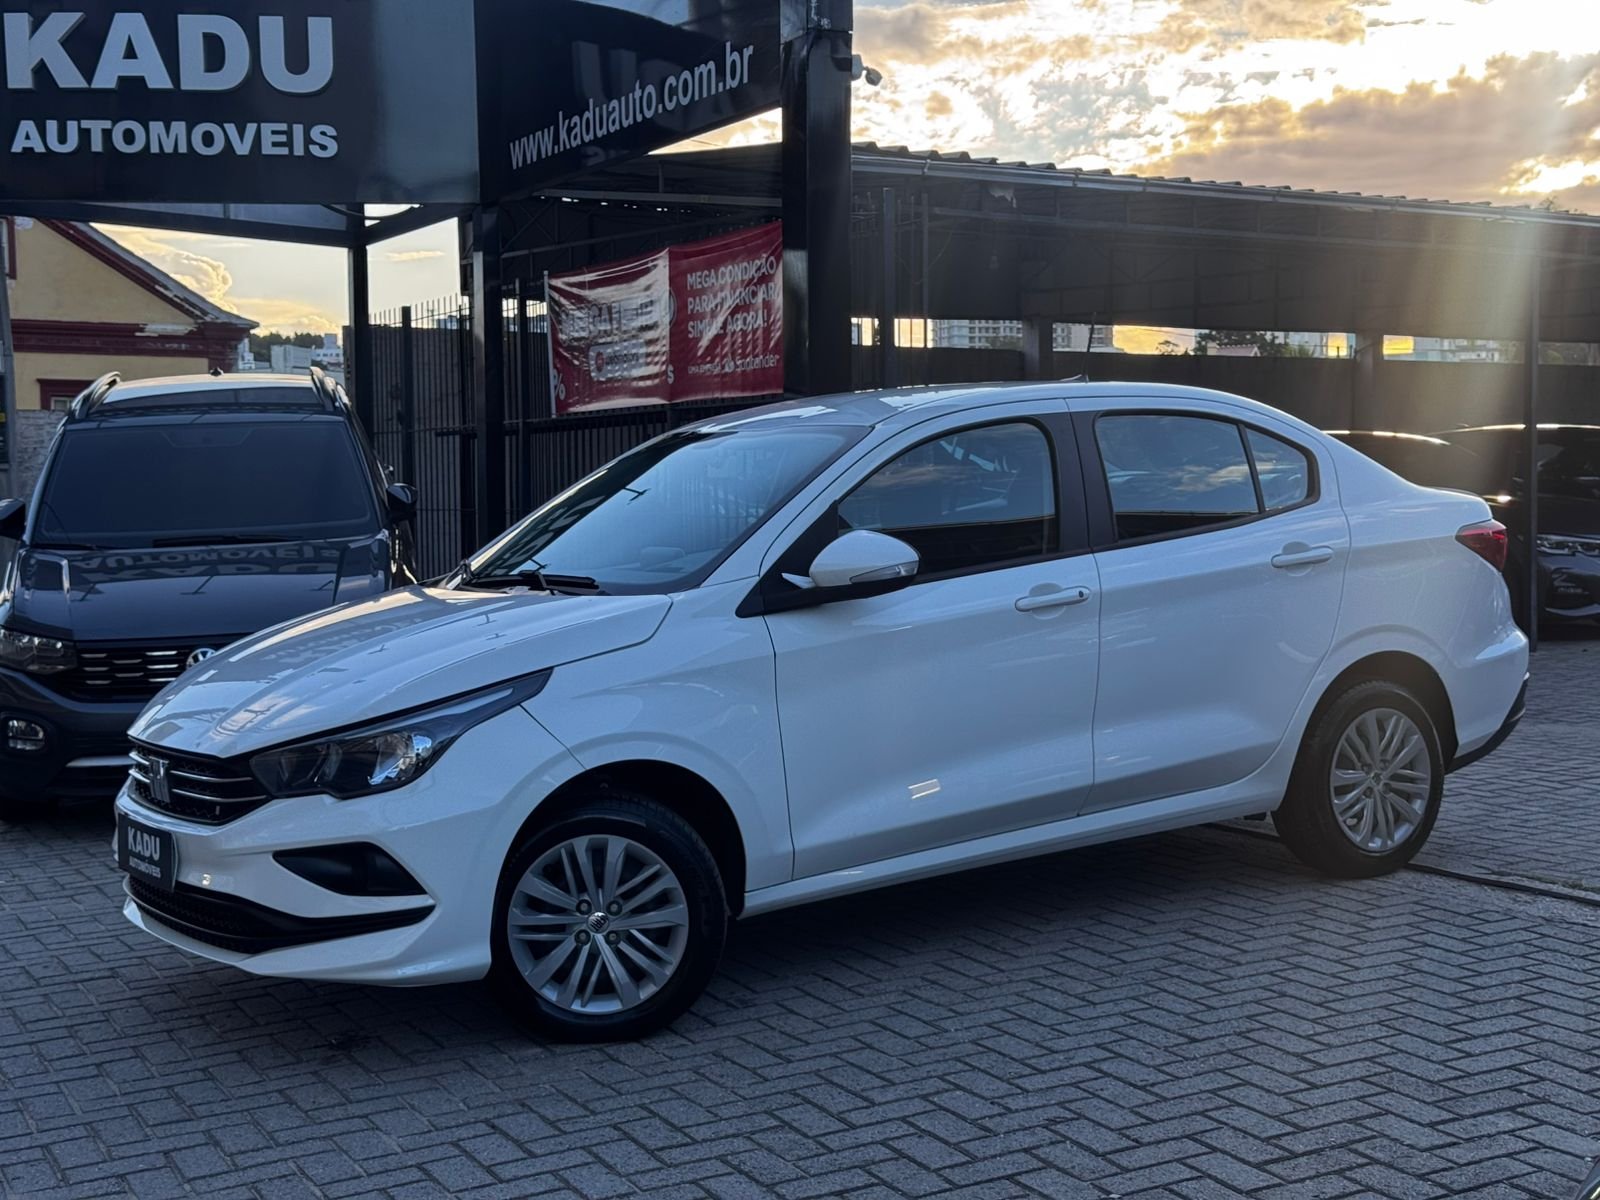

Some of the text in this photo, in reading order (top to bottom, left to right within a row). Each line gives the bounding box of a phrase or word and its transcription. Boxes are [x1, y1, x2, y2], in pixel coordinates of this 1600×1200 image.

[3, 12, 334, 93] KADU
[509, 41, 754, 170] www.kaduauto.com.br
[10, 119, 339, 158] AUTOMOVEIS
[687, 269, 716, 290] MEGA
[687, 294, 716, 315] PARA
[128, 826, 160, 860] KADU
